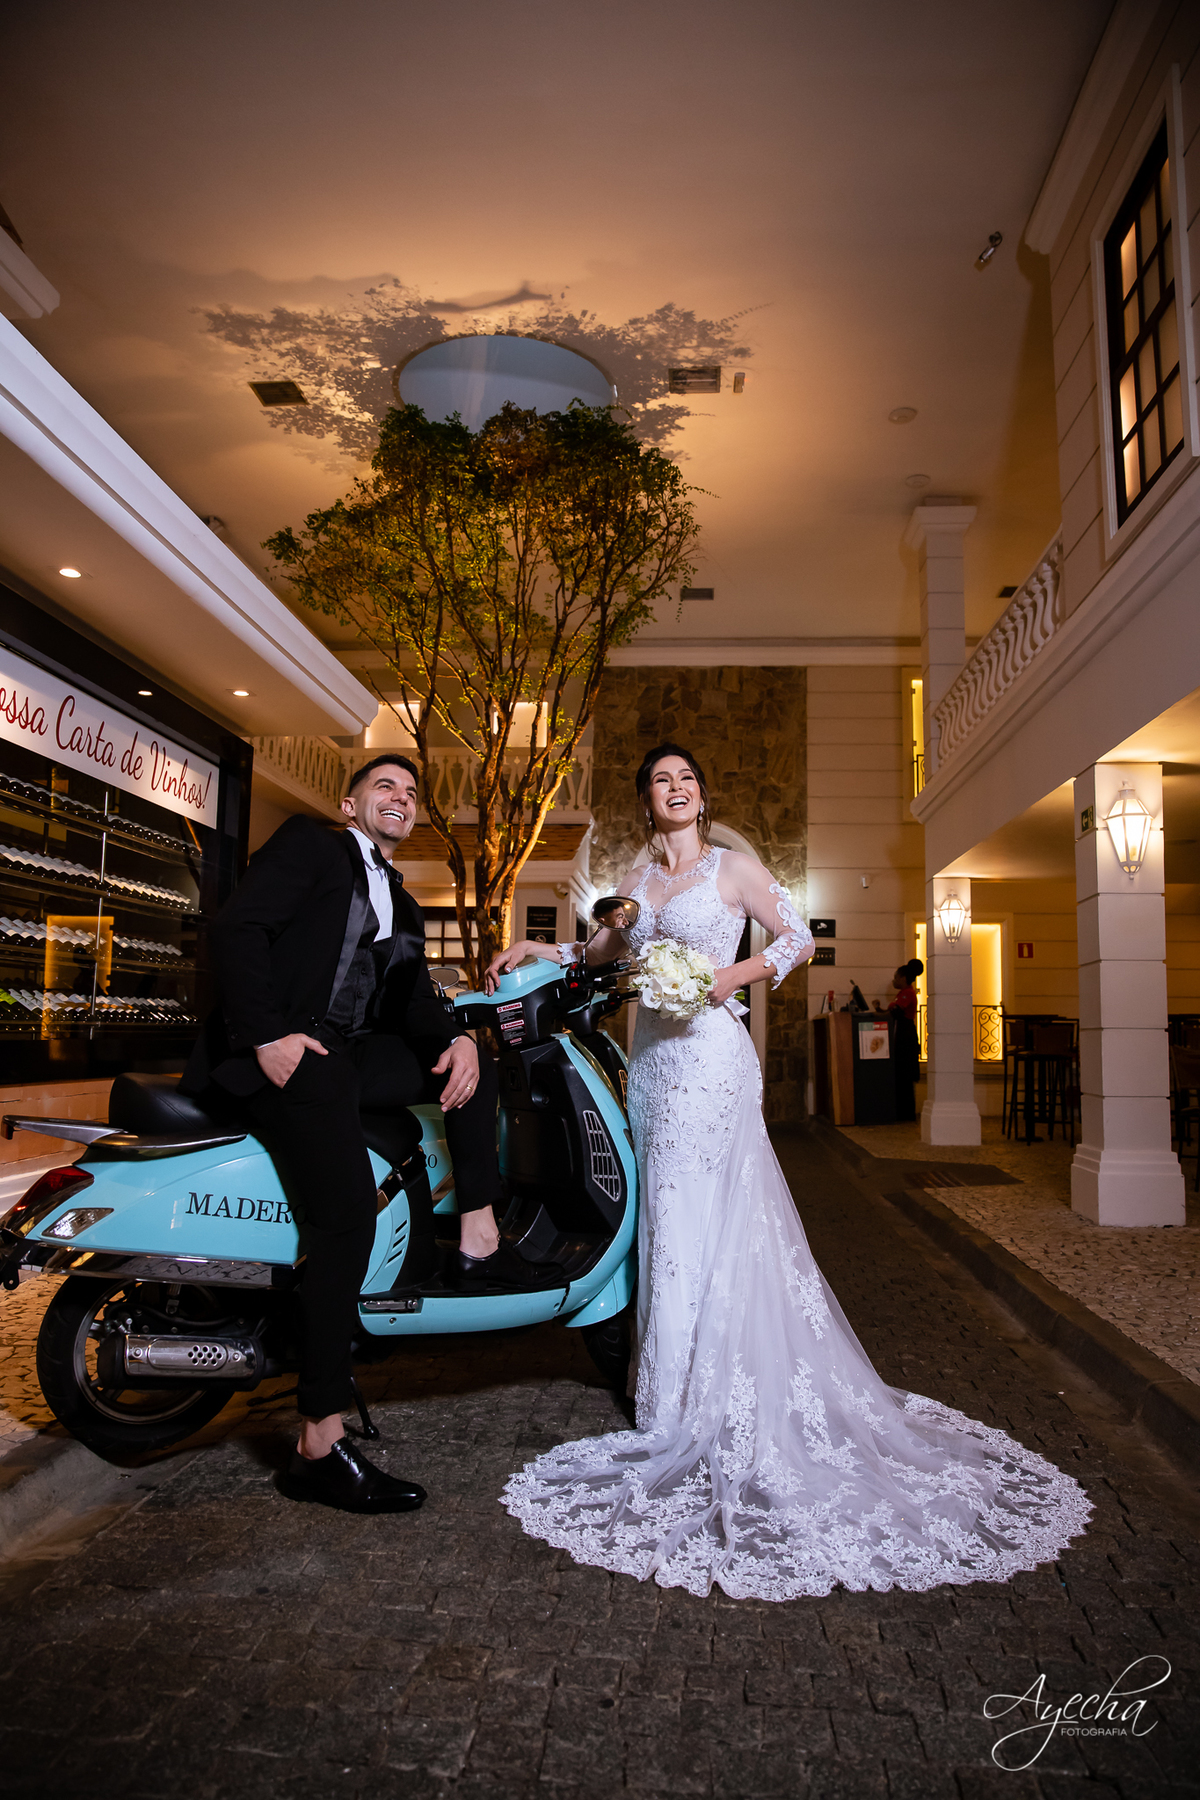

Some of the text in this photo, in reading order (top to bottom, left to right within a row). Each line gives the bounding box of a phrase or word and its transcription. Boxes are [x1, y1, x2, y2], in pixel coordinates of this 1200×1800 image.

[56, 695, 117, 767] Carta
[120, 731, 145, 780] de
[150, 740, 212, 809] Vinhos!
